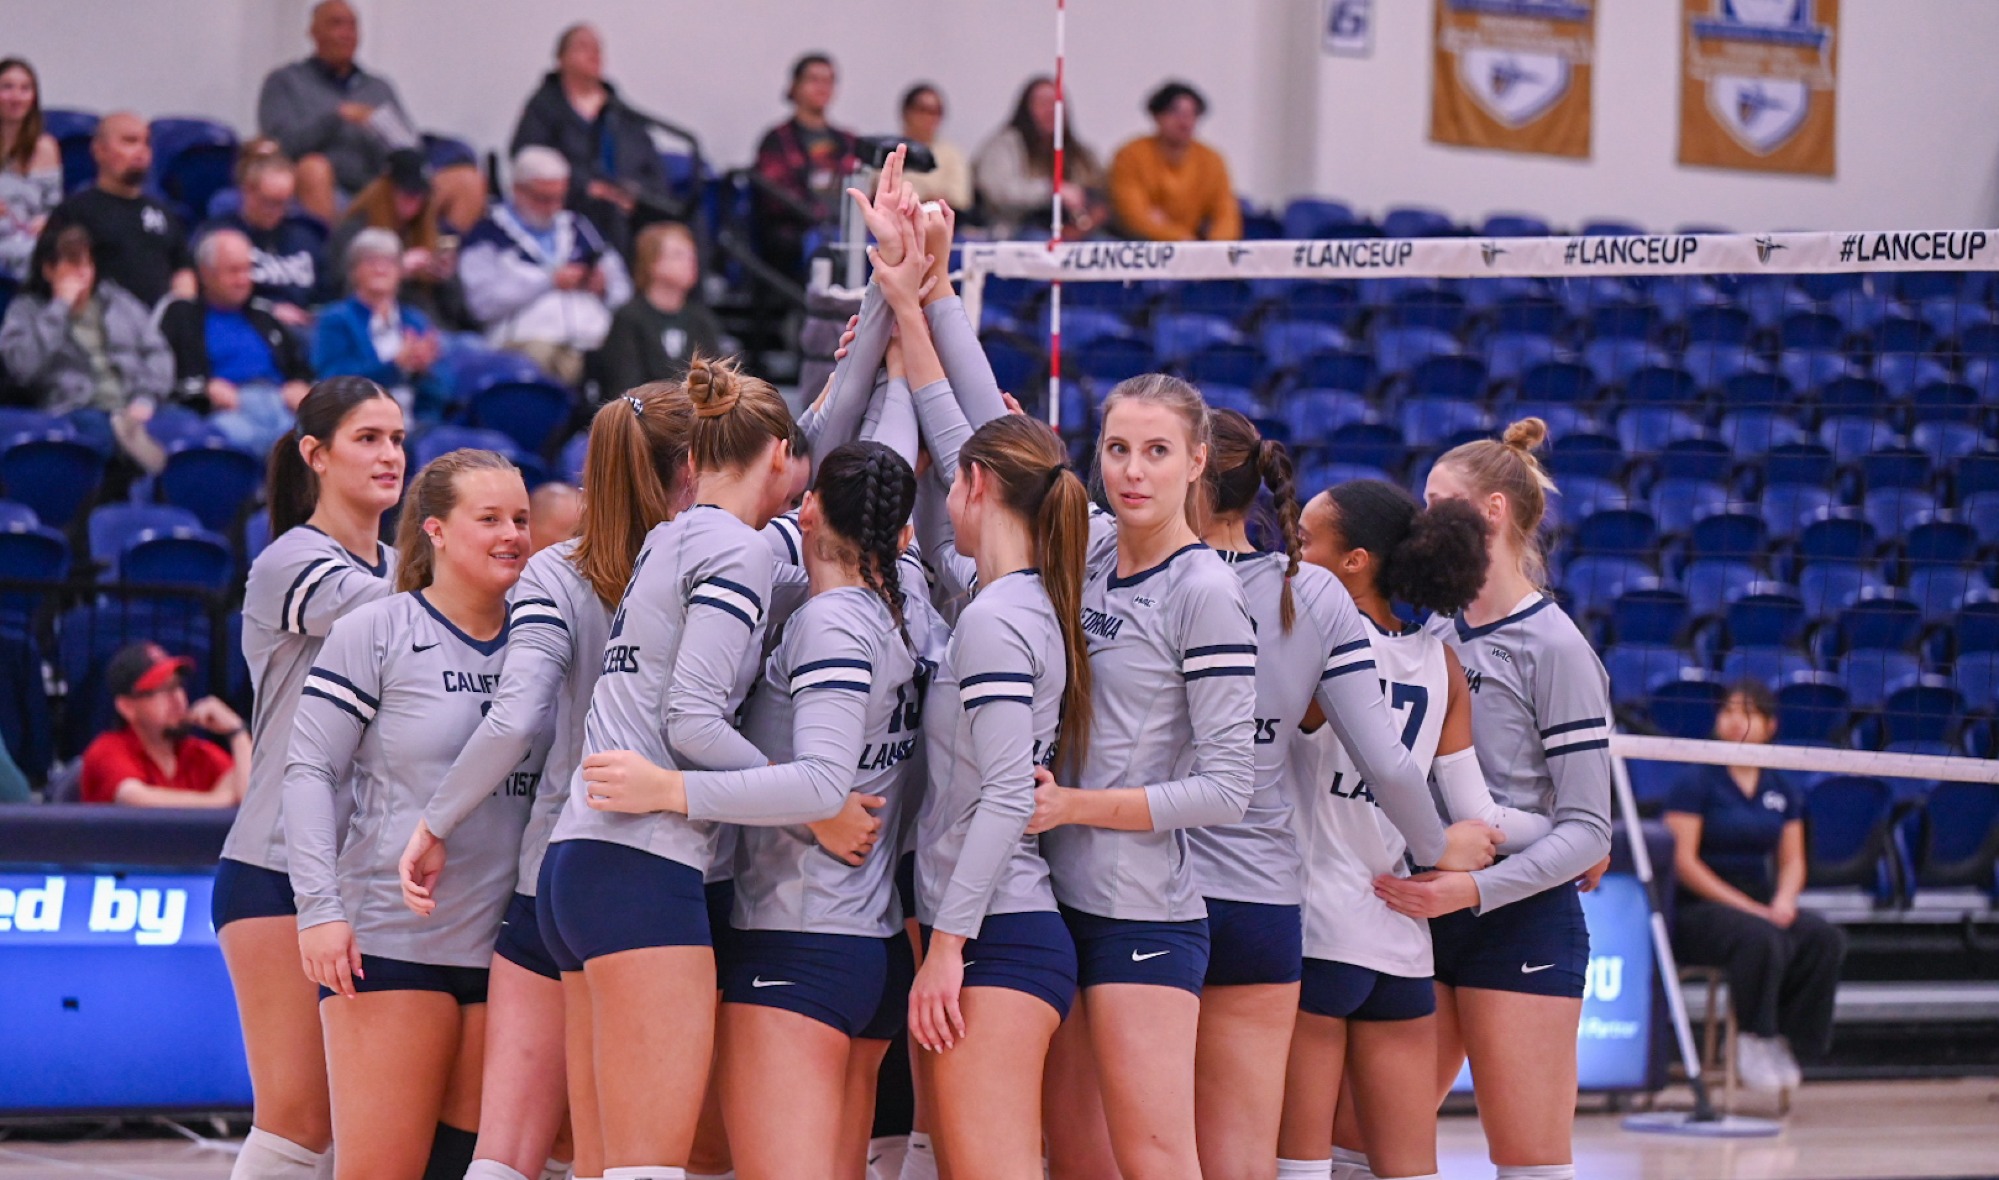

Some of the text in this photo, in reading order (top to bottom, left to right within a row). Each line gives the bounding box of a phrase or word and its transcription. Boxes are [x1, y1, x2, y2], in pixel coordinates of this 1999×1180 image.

[1294, 242, 1413, 269] #LANCEUP
[1564, 237, 1698, 265] #LANCEUP
[1840, 231, 1987, 262] #LANCEUP
[1491, 647, 1513, 663] WAC
[1379, 678, 1429, 752] 7
[504, 771, 541, 797] TIST
[88, 875, 188, 946] by
